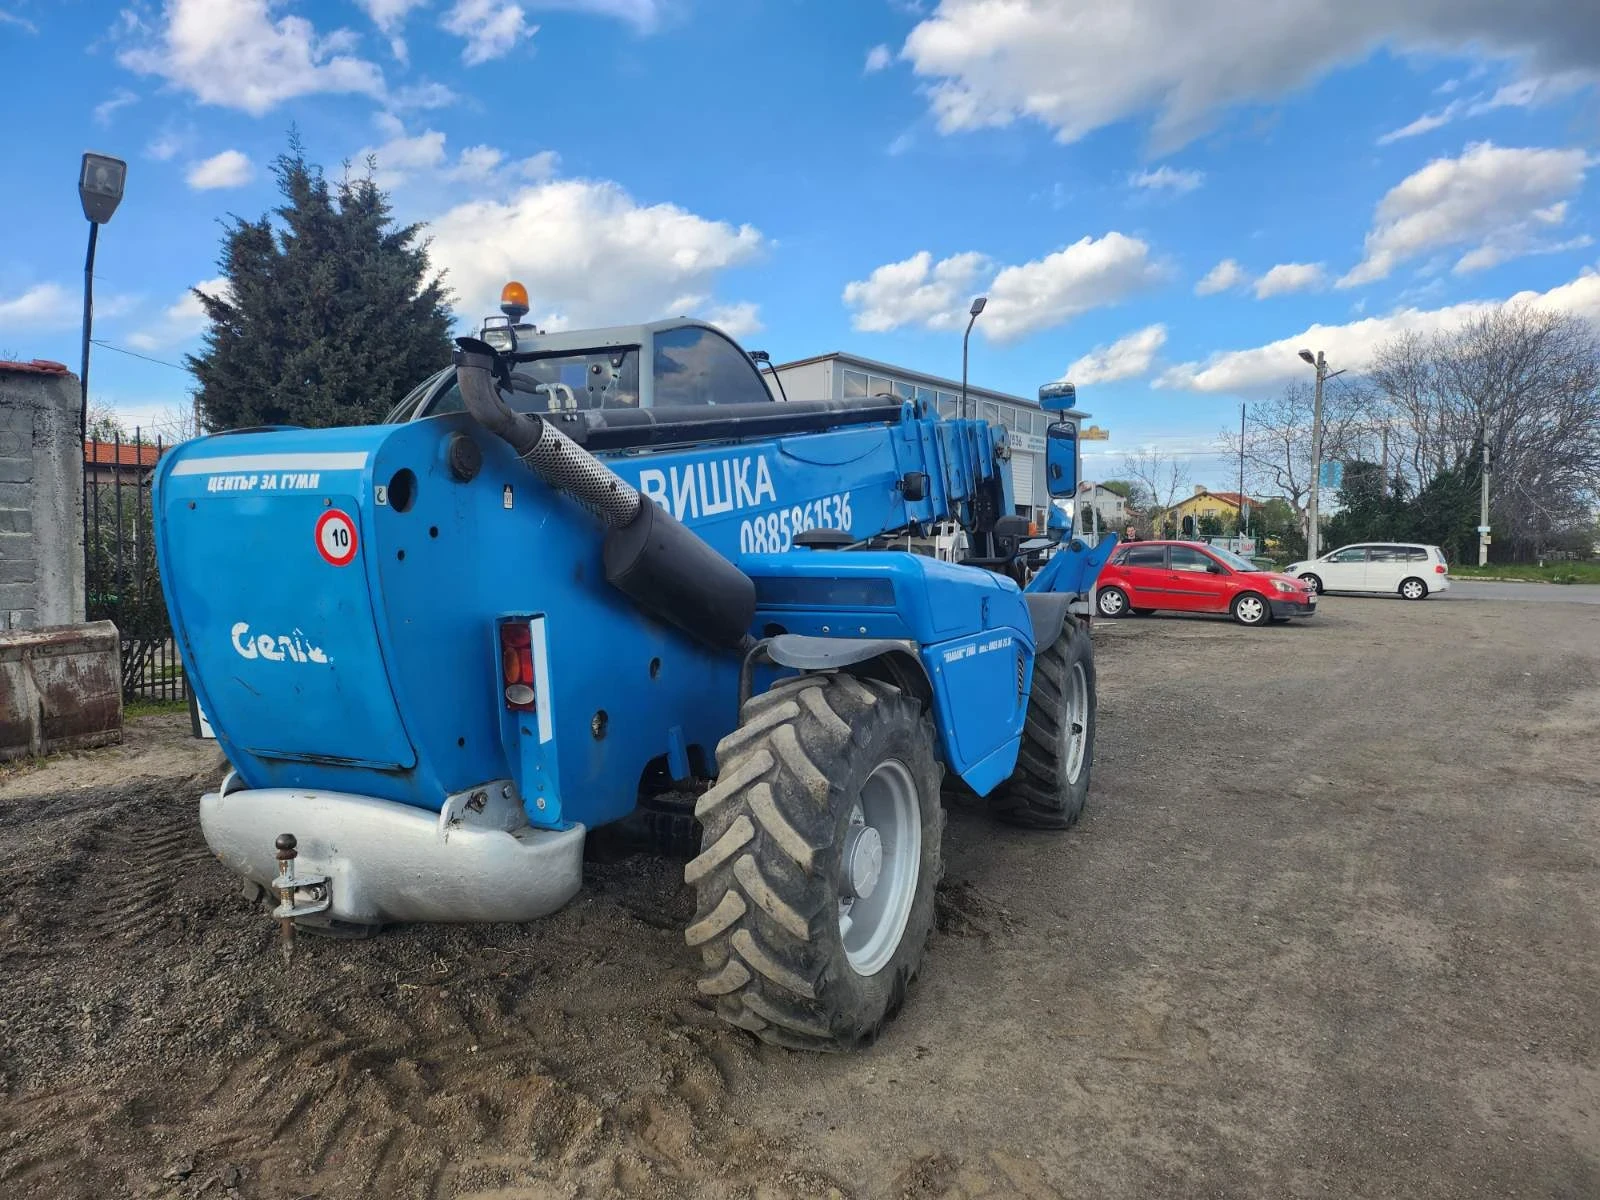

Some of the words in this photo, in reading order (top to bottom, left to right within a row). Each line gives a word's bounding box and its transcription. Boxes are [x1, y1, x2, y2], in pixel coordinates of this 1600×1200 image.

[207, 475, 258, 492] ЦЕНТЪР
[260, 474, 277, 490] ЗА
[280, 473, 320, 489] ГУМИ
[639, 454, 777, 522] ВИШКА
[332, 528, 349, 547] 10
[740, 491, 852, 554] 0885861536
